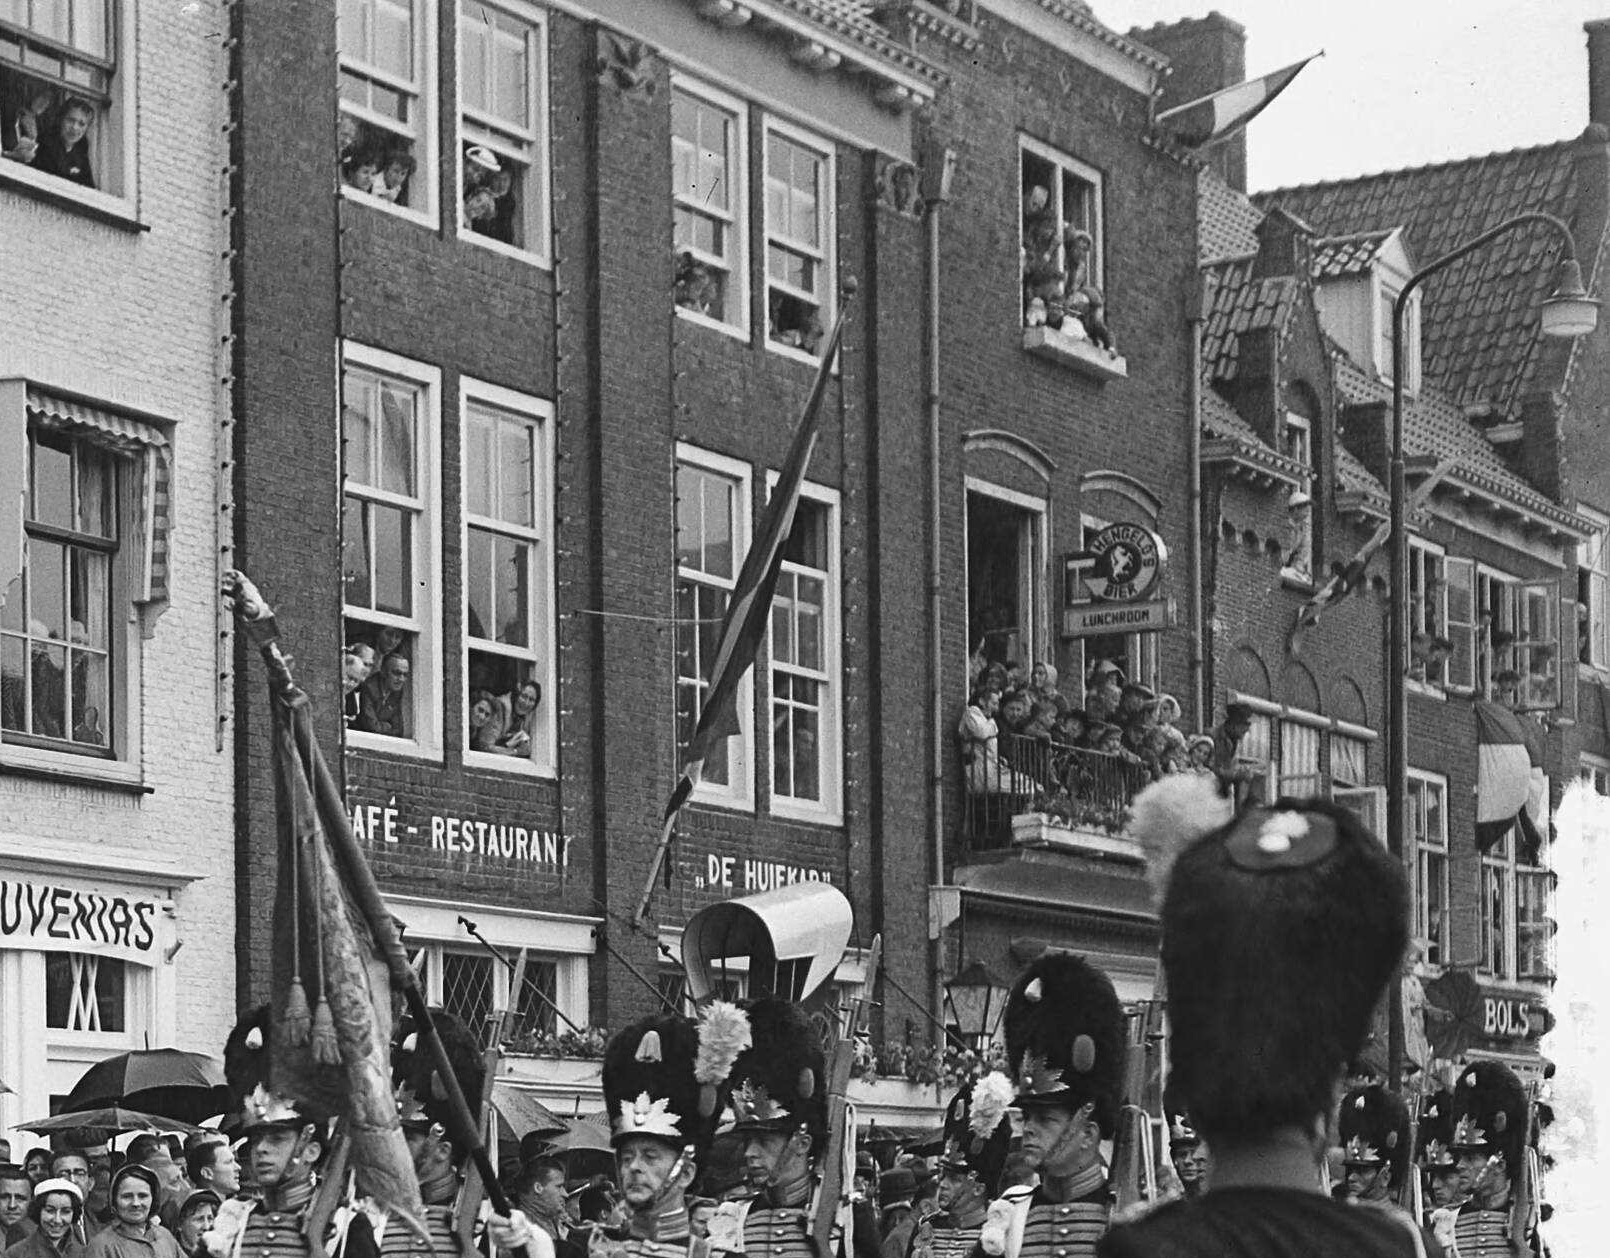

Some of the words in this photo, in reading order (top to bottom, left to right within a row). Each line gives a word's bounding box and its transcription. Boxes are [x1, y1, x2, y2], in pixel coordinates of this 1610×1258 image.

[1103, 583, 1139, 599] BIER
[1082, 609, 1150, 627] LUNCHROOM
[346, 796, 399, 843] AFÉ
[431, 815, 572, 867] RESTAURANT
[1484, 998, 1529, 1036] BOLS
